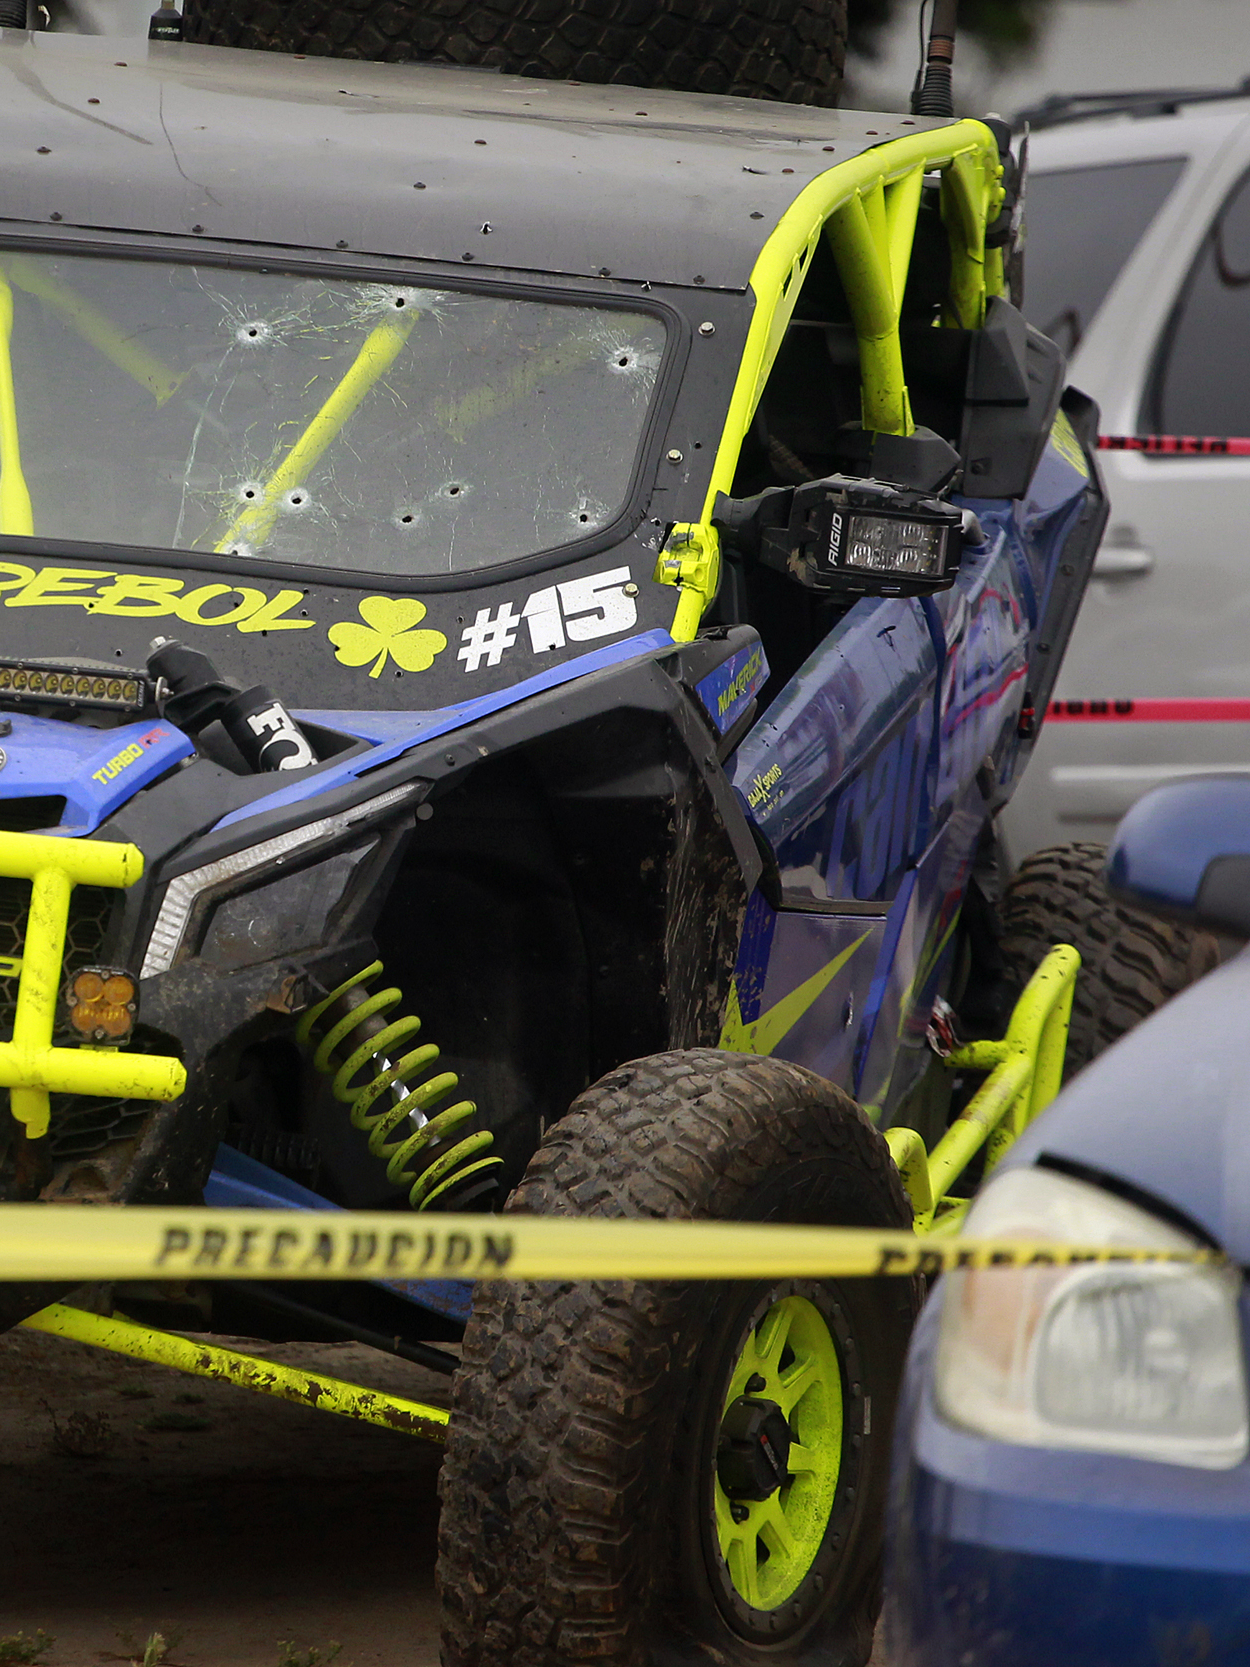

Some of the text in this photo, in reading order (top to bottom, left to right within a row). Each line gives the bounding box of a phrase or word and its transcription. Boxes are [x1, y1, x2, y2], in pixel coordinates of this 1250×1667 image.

[828, 512, 843, 567] RIGID
[457, 566, 638, 673] #15
[717, 645, 762, 717] MAVERICK
[91, 743, 145, 786] TURBO
[247, 702, 319, 771] FO
[154, 1227, 516, 1269] PRECAUCION
